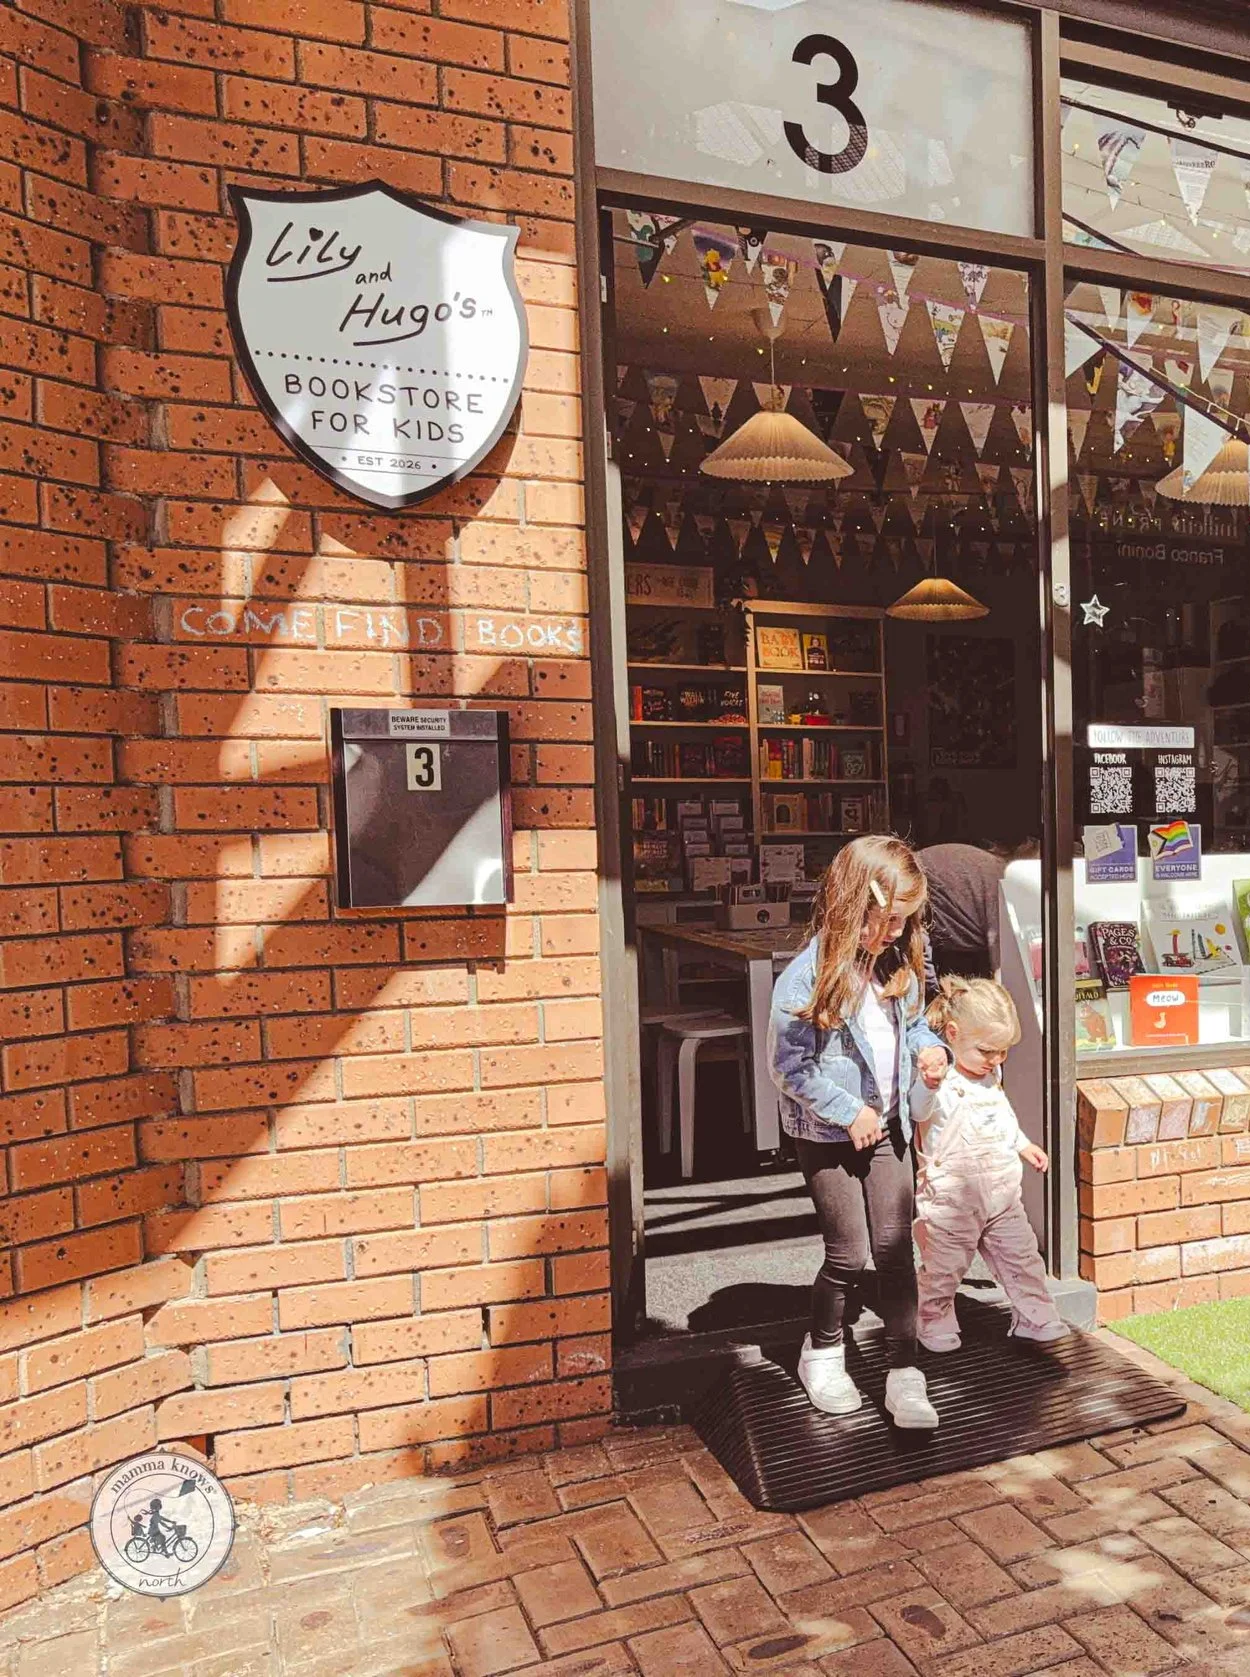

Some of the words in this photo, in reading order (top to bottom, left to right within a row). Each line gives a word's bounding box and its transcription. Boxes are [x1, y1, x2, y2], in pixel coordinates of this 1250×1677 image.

[783, 33, 868, 174] 3
[266, 222, 362, 282] Lily
[355, 262, 393, 285] and
[339, 291, 477, 346] Hugo's
[284, 373, 484, 414] BOOKSTORE
[311, 410, 371, 436] FOR
[392, 418, 465, 444] KIDS
[357, 455, 383, 468] EST
[180, 607, 316, 640] COME
[476, 618, 582, 653] BOOKS
[391, 716, 419, 724] BEWARE
[1145, 730, 1191, 745] ADVENTURE
[414, 746, 435, 788] 3
[1093, 753, 1127, 765] FACEBOOK
[1157, 754, 1192, 765] INSTAGRAM
[1155, 864, 1198, 873] EVERYONE
[1101, 927, 1135, 939] PAGES
